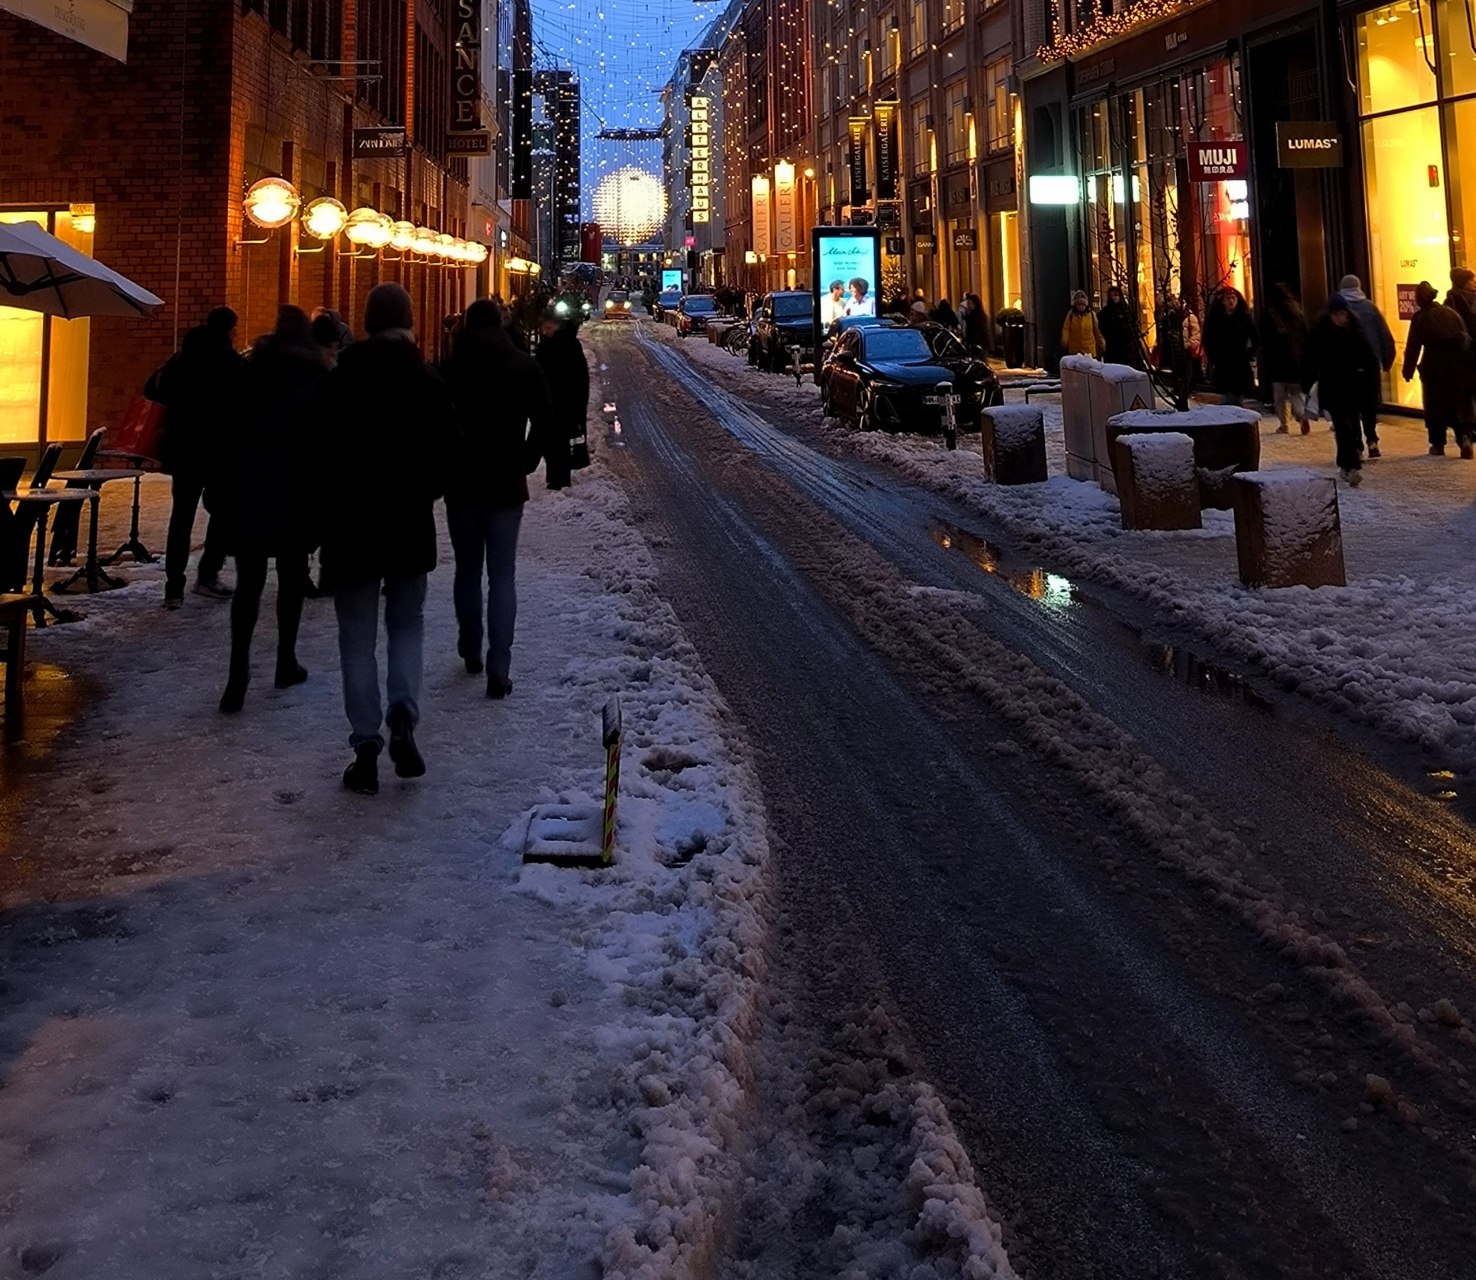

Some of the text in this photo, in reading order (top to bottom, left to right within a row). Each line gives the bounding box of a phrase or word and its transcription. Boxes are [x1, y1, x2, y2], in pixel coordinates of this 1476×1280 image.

[449, 139, 486, 149] HOTEL
[853, 126, 863, 190] KAISERGALERIE
[880, 112, 890, 181] KAISERGALERIE
[1199, 149, 1237, 165] MUJI
[1288, 139, 1331, 149] LUMAS
[756, 192, 768, 252] GALLERI
[780, 181, 792, 247] GALLERI
